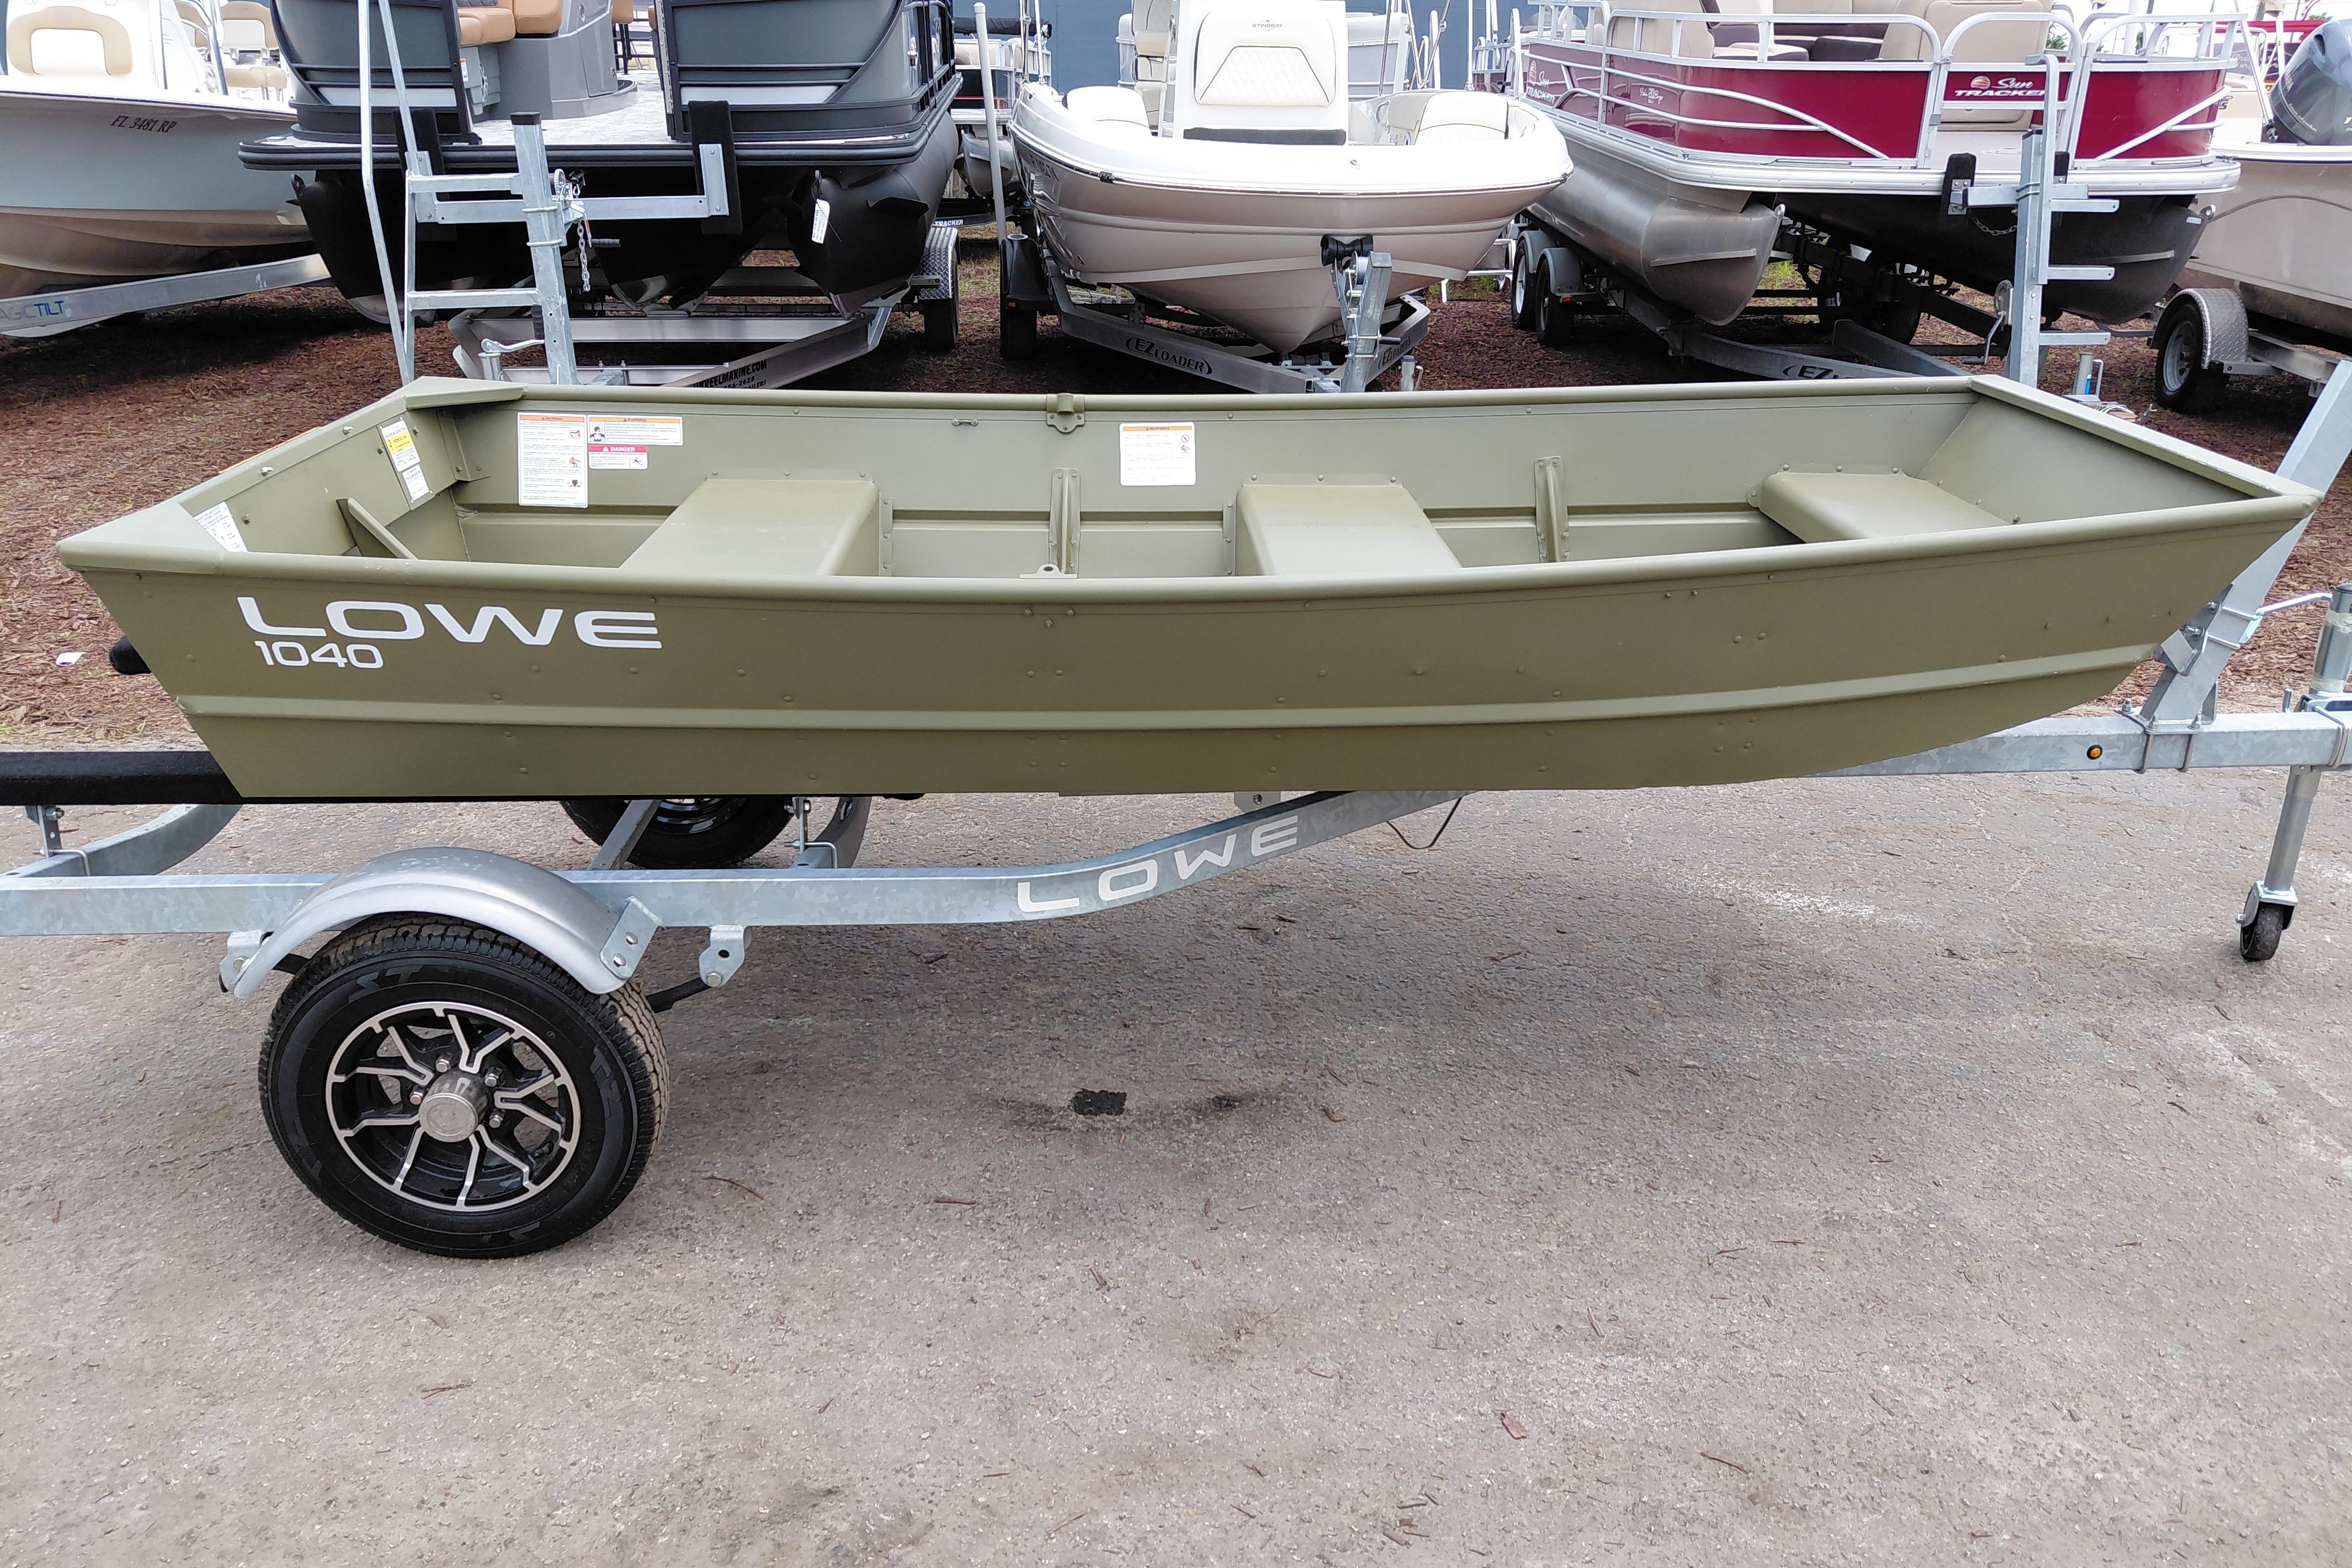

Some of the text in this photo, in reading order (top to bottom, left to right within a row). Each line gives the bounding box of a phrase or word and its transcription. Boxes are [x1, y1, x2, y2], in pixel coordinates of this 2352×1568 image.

[1992, 77, 2033, 89] Sun
[110, 115, 178, 133] FL 3481 RP
[237, 597, 662, 649] LOWE
[254, 640, 383, 669] 1040
[1017, 815, 1299, 913] LOWE
